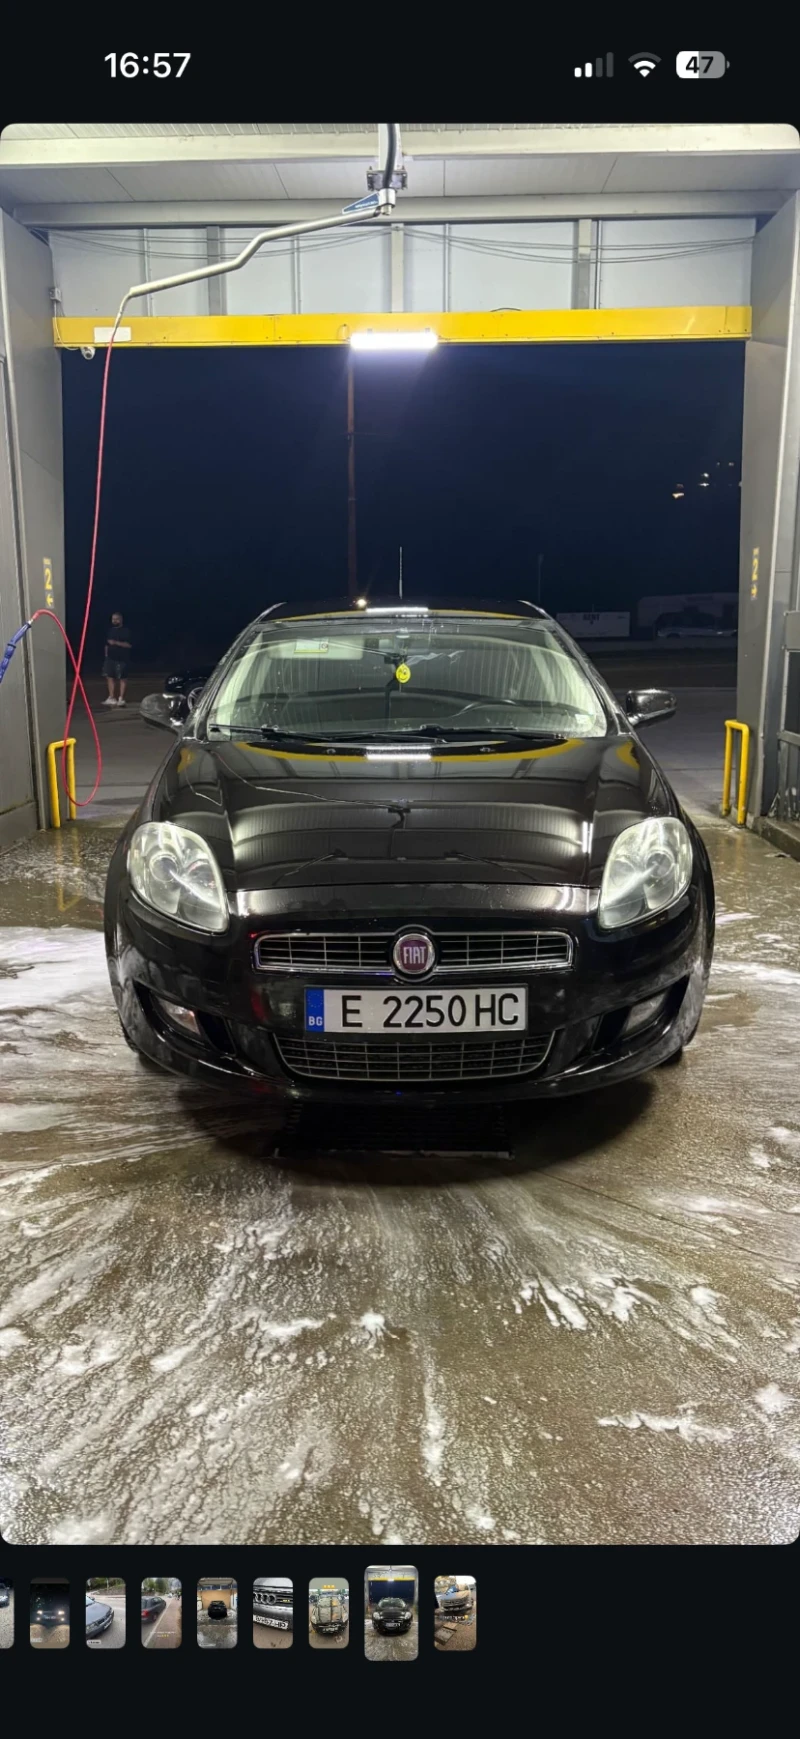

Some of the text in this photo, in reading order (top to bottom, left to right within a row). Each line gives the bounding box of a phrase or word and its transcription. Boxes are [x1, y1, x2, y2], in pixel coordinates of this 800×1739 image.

[44, 567, 53, 590] 2
[752, 558, 759, 581] 2
[403, 946, 427, 964] FIAT
[308, 1016, 323, 1026] BG
[341, 993, 519, 1028] E 2250 HC
